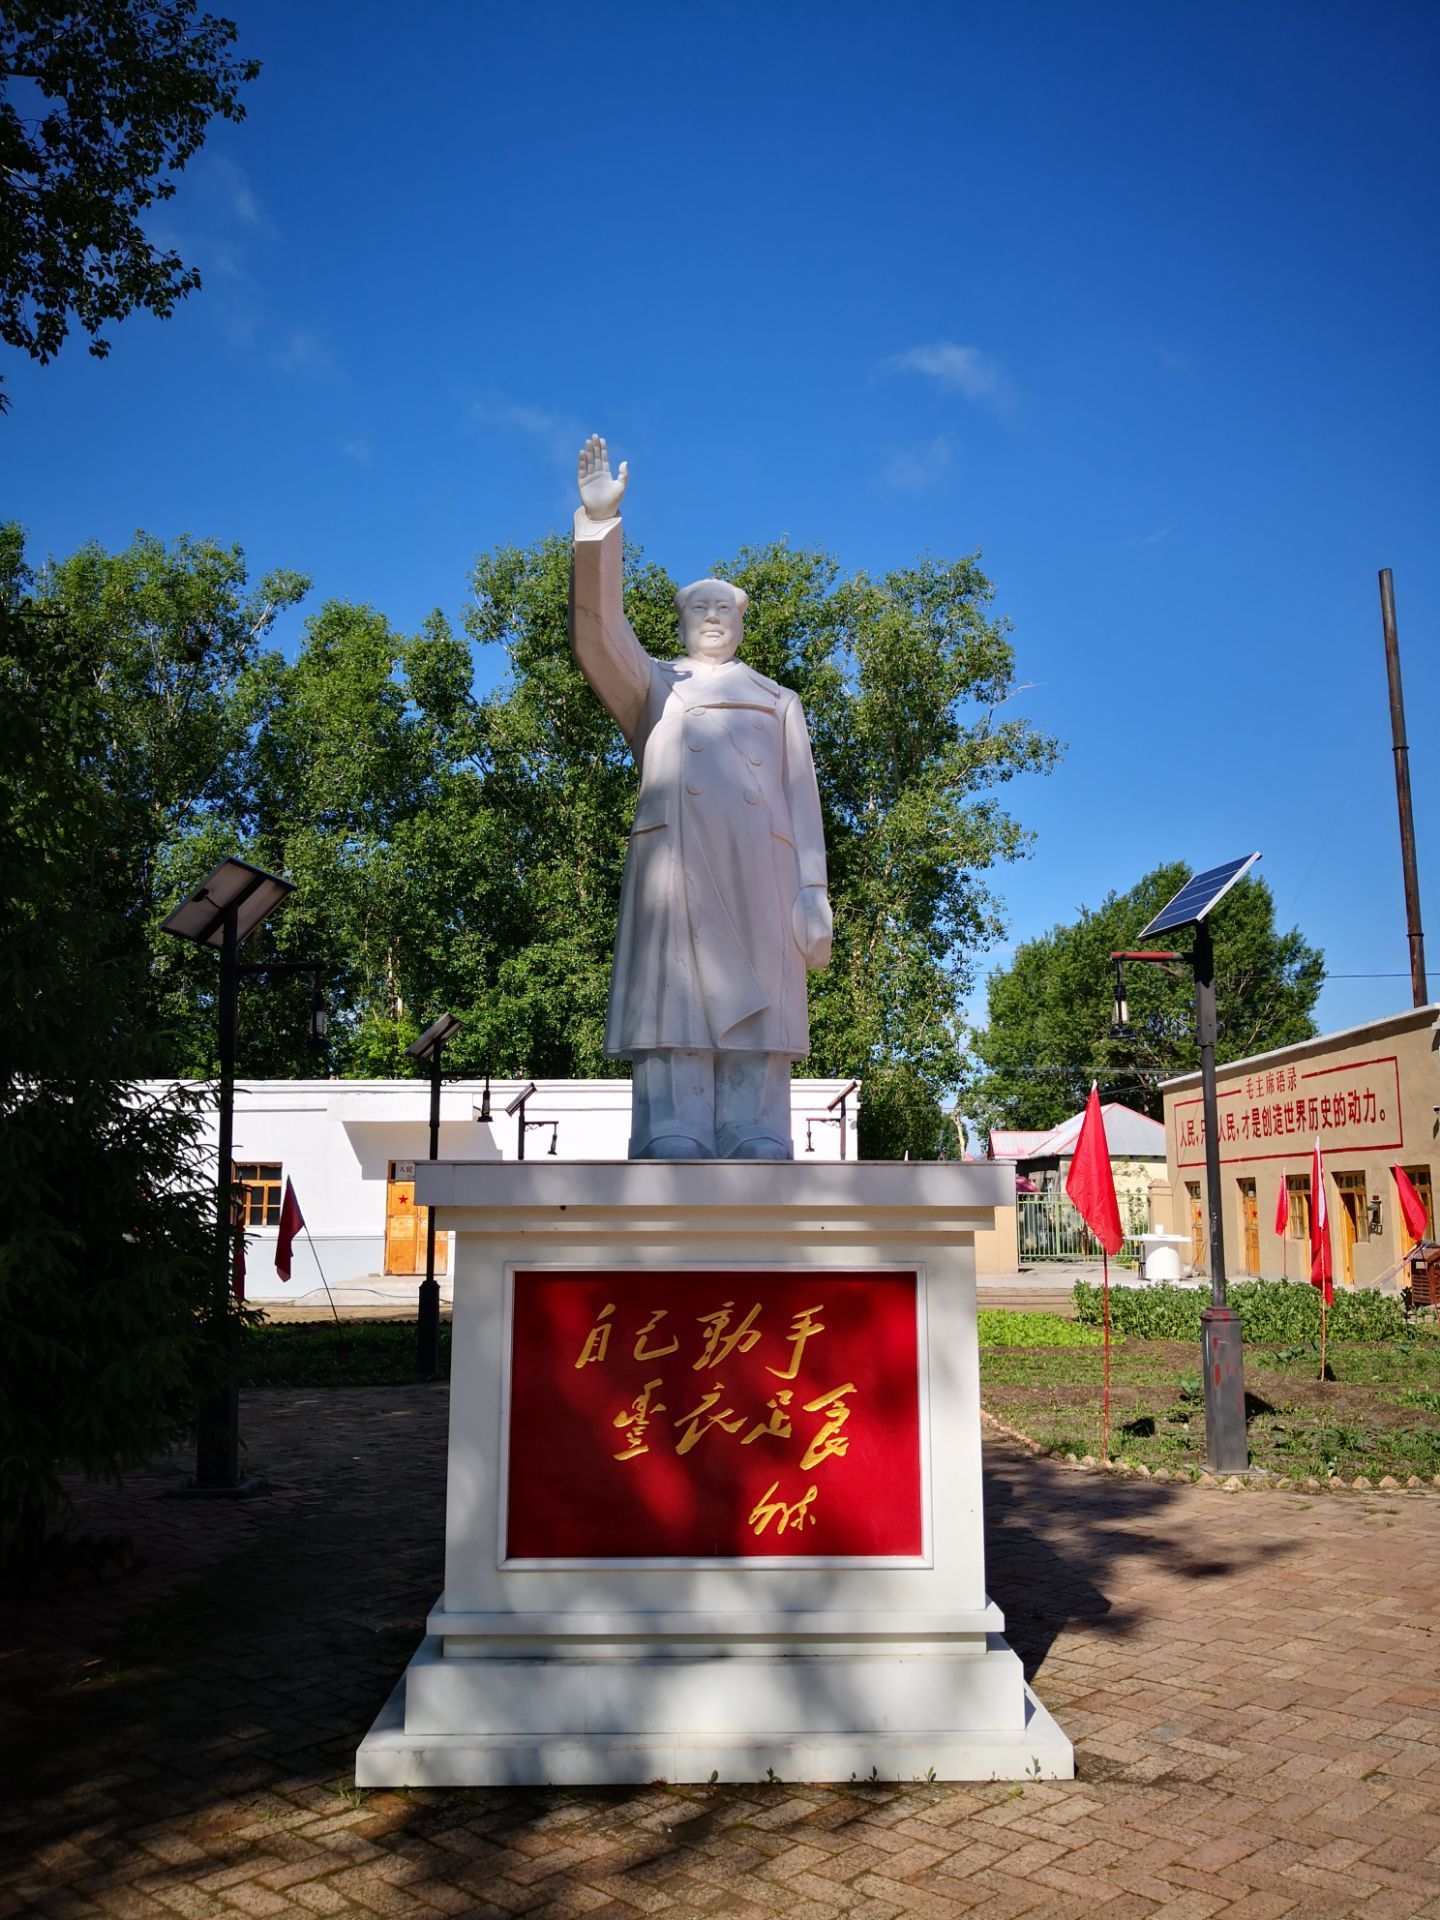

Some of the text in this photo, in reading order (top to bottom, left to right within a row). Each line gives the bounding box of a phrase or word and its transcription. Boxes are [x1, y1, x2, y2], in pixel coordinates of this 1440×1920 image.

[1245, 1066, 1298, 1100] 毛主席语录
[1179, 1087, 1387, 1148] 人民，只人民，才是创造世界历史的动力。
